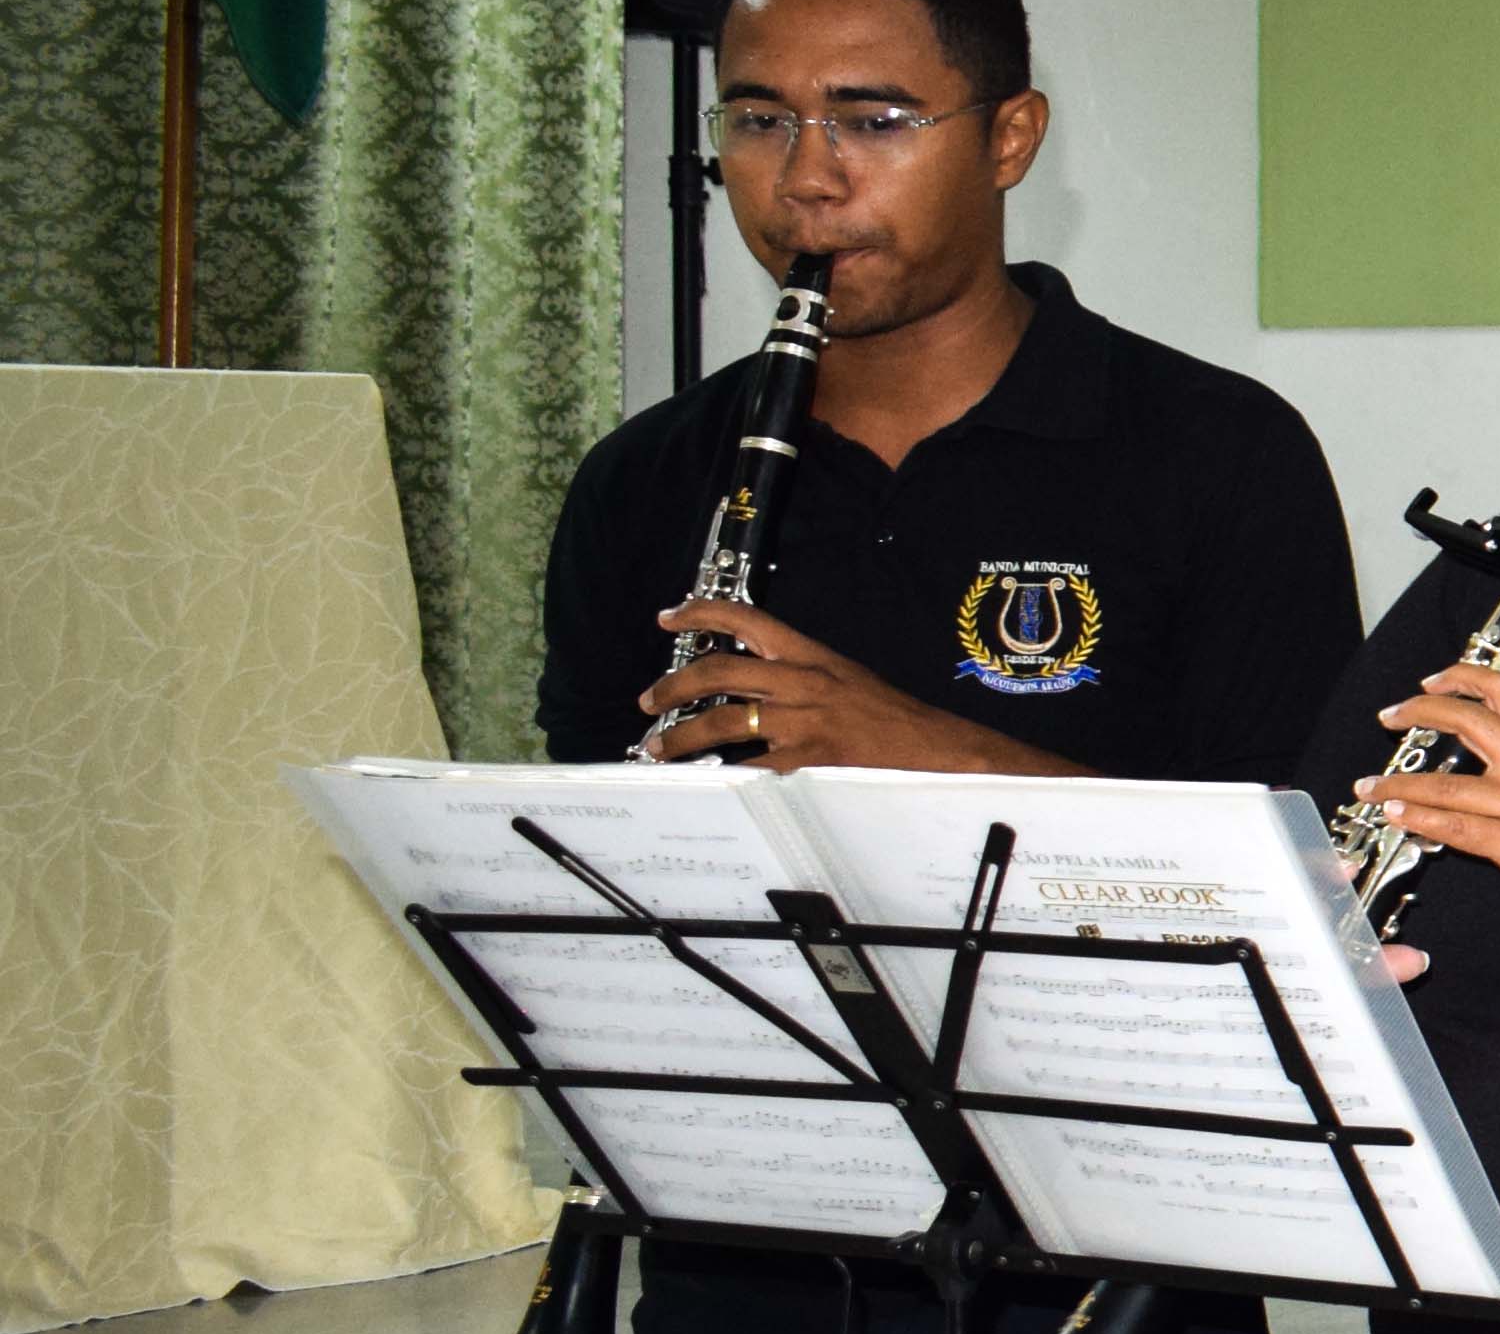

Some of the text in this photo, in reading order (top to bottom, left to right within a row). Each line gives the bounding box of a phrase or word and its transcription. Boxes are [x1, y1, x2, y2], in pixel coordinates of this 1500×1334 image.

[1023, 561, 1090, 576] MUNICIPAL
[1039, 882, 1134, 902] CLEAR
[1139, 886, 1224, 906] BOOK
